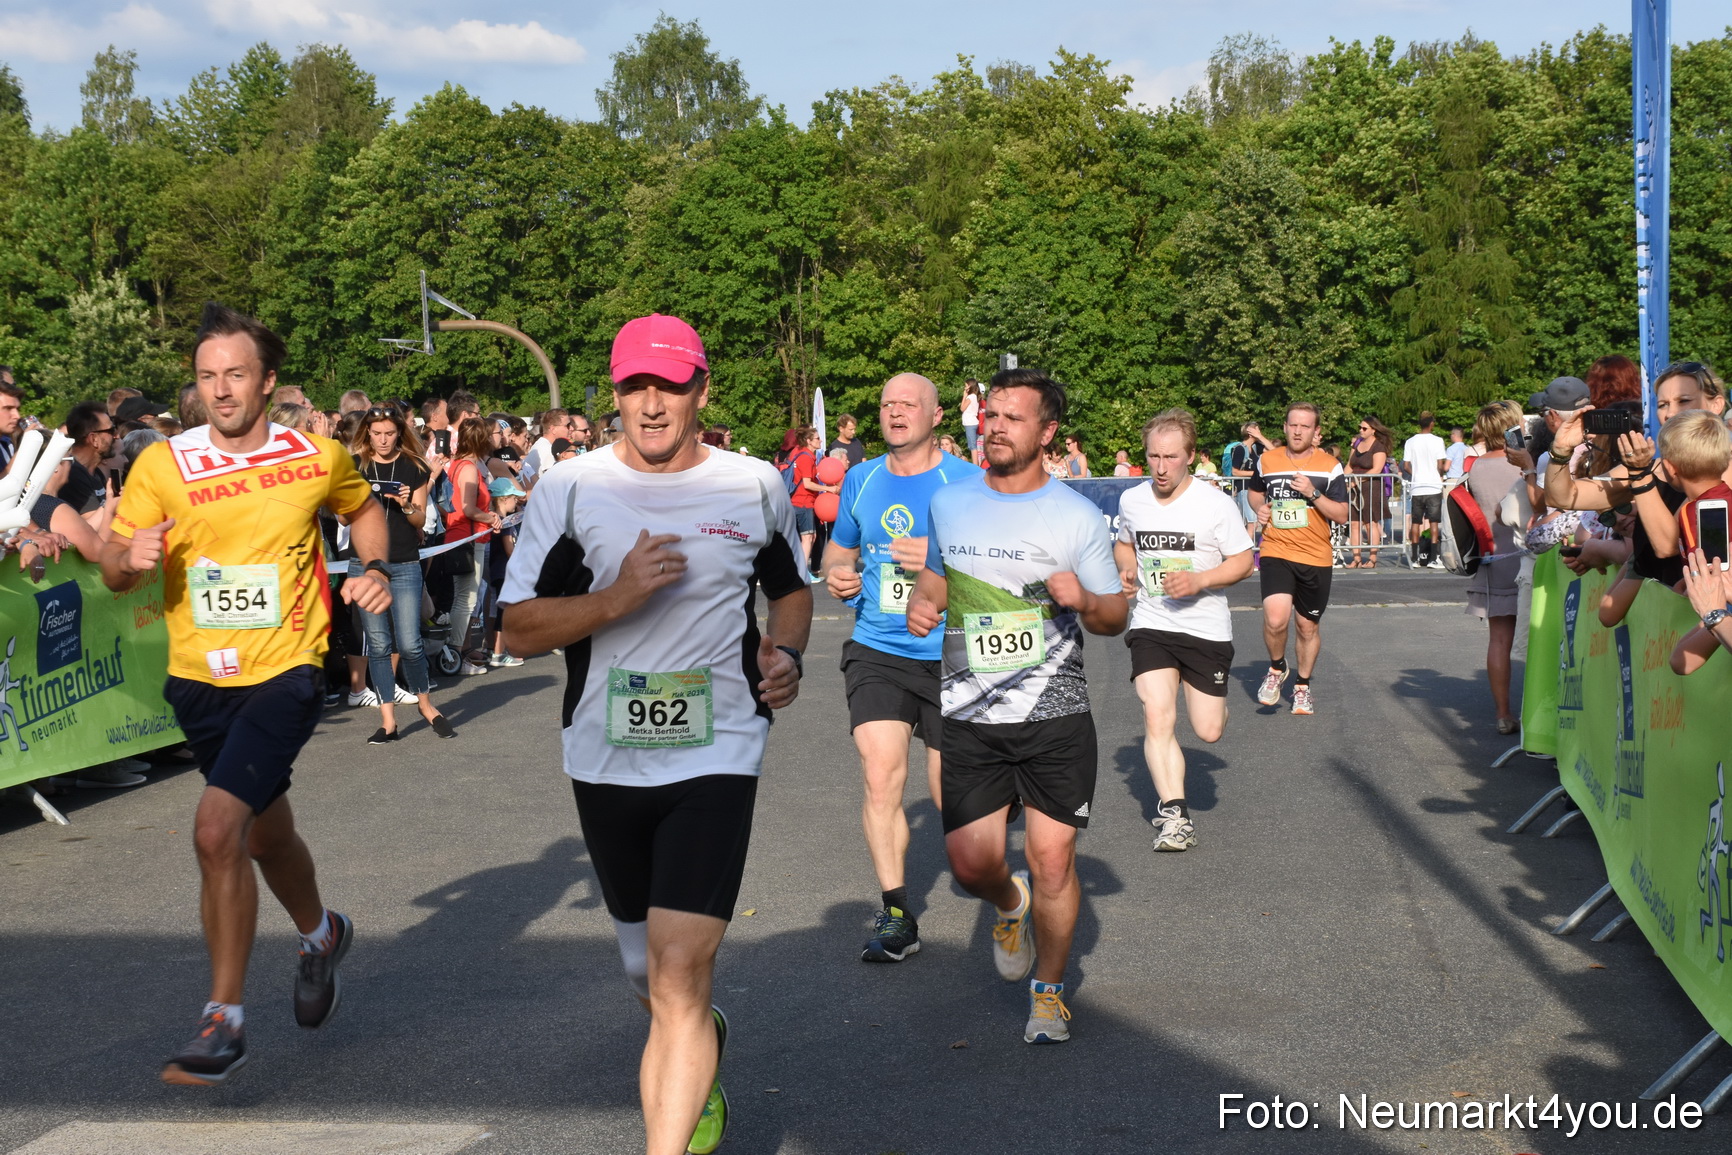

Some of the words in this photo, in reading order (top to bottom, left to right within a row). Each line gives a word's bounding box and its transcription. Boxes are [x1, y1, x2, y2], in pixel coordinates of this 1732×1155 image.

[187, 479, 252, 507] MAX
[258, 463, 328, 489] BÖGL
[721, 519, 740, 527] TEAM
[1277, 510, 1297, 521] 761
[708, 528, 750, 540] partner
[1150, 571, 1167, 586] 15
[202, 587, 267, 612] 1554
[892, 582, 917, 601] 97
[46, 609, 77, 631] Fischer
[975, 631, 1033, 656] 1930
[20, 636, 124, 723] firmenlauf
[622, 685, 662, 695] firmenlauf
[628, 699, 689, 727] 962
[31, 709, 78, 743] neumarkt
[628, 727, 653, 735] Metka
[655, 727, 690, 735] Berthold
